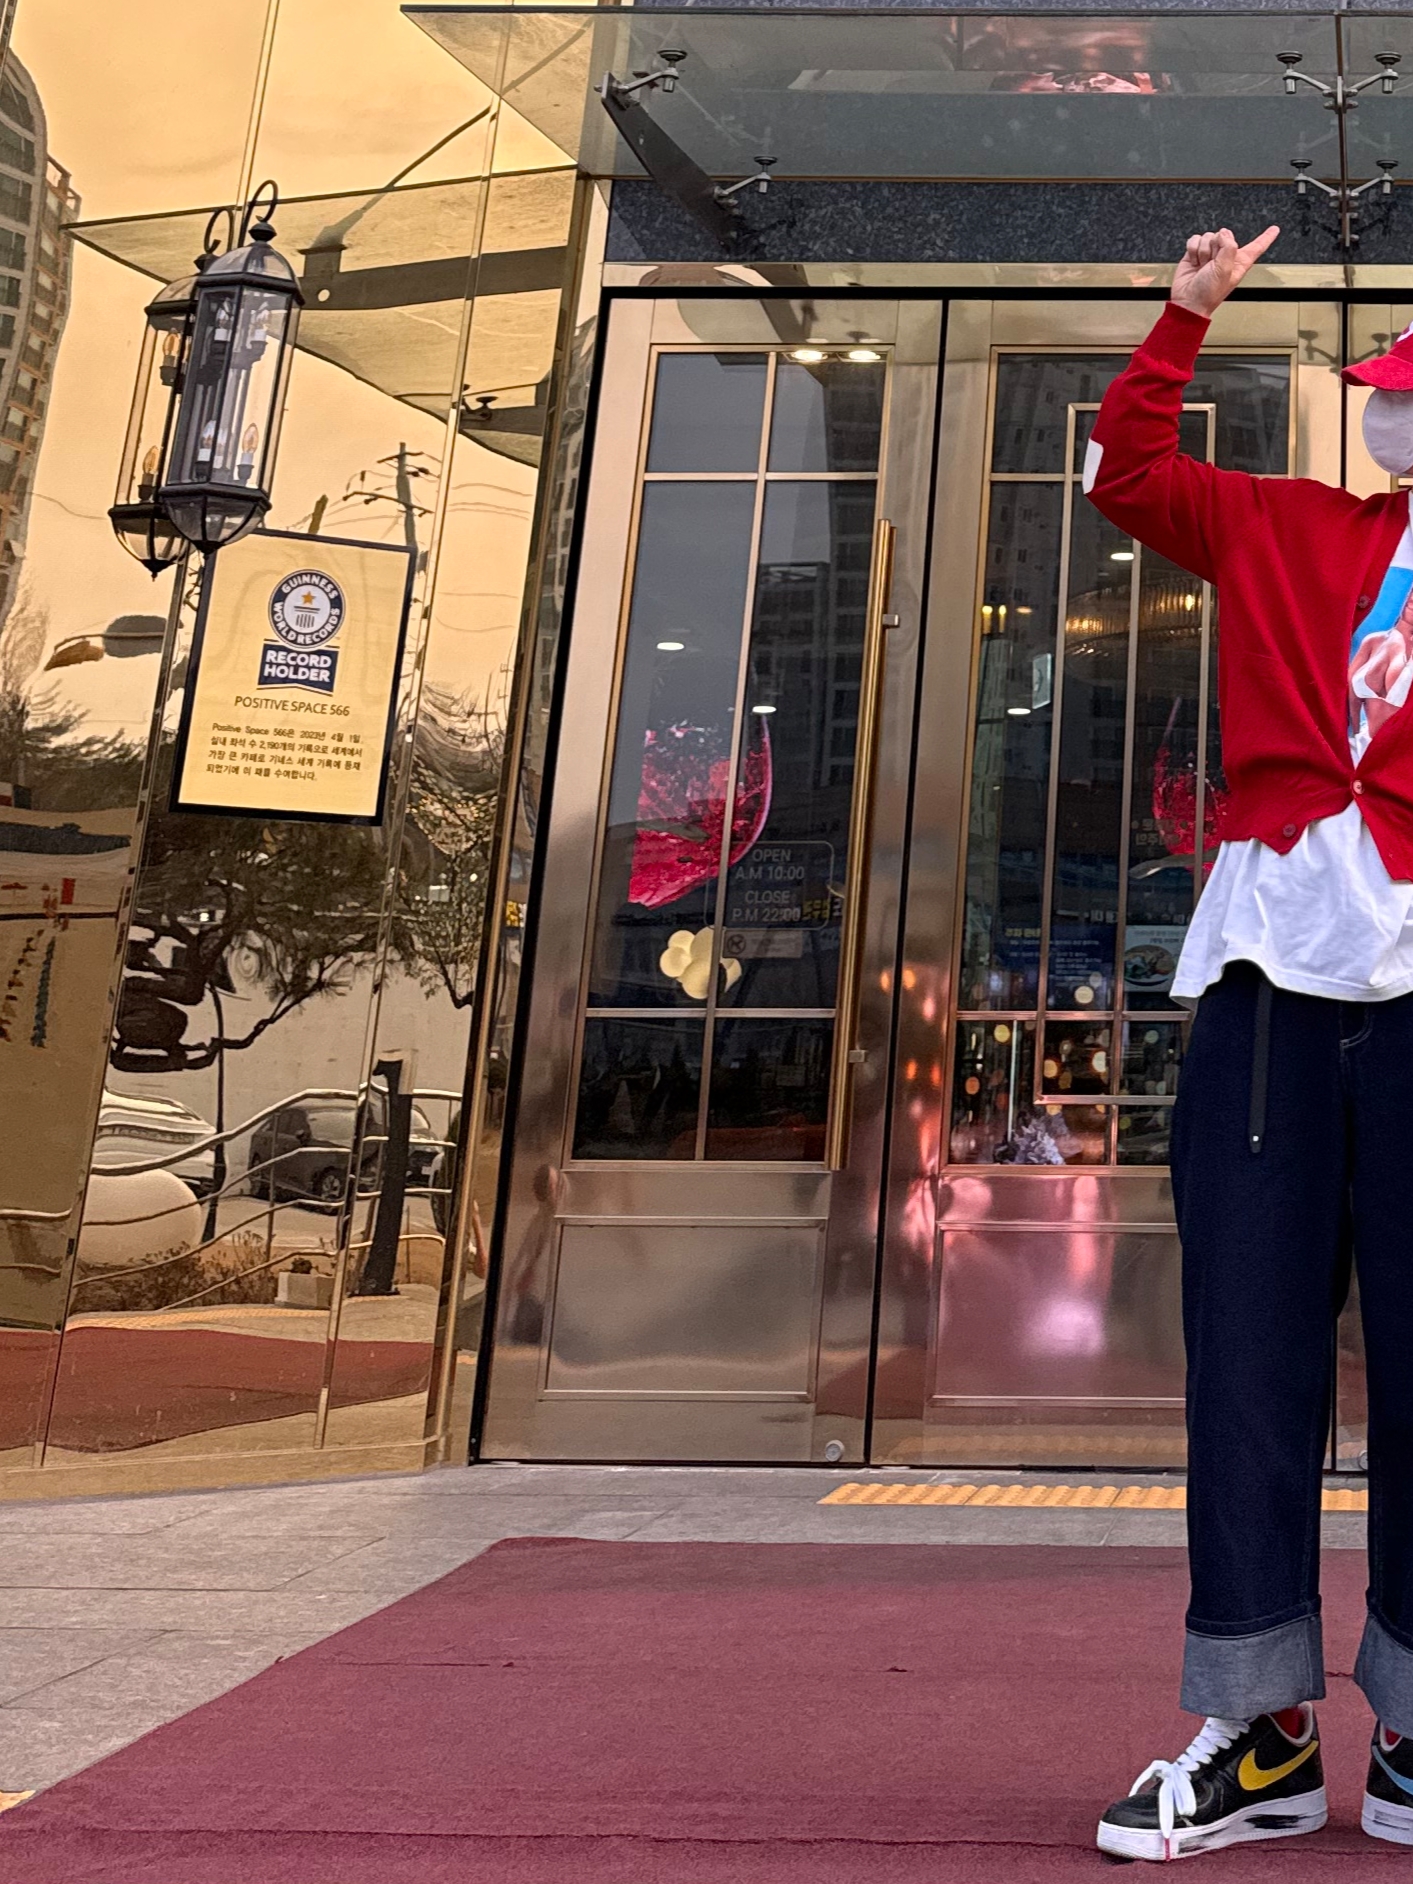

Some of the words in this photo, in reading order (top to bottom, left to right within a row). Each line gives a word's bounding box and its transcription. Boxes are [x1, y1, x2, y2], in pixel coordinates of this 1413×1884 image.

[280, 573, 339, 600] GUINNESS
[272, 601, 299, 644] WORLD
[297, 607, 341, 644] RECORDS
[265, 649, 332, 668] RECORD
[263, 664, 331, 683] HOLDER
[234, 696, 291, 713] POSITIVE
[290, 701, 330, 715] SPACE
[329, 704, 351, 717] 566
[212, 722, 242, 733] Positive
[245, 725, 270, 737] Space
[208, 749, 226, 761] 가장
[268, 754, 294, 766] 기네스
[752, 848, 792, 863] OPEN
[734, 865, 763, 880] A.M
[767, 865, 806, 880] 10:00
[744, 890, 791, 904] CLOSE
[730, 908, 759, 923] P.M
[761, 907, 802, 923] 22:00
